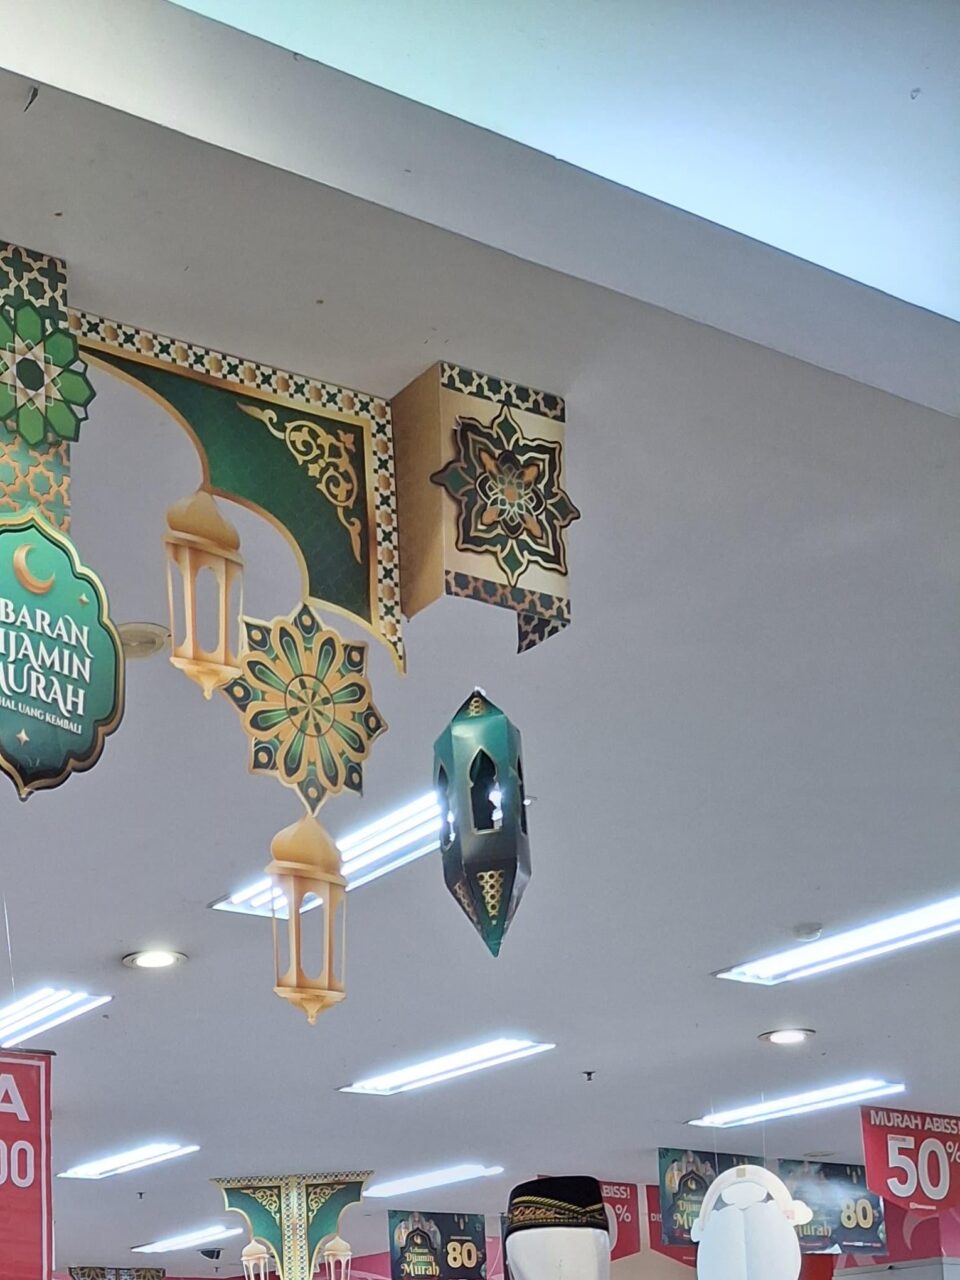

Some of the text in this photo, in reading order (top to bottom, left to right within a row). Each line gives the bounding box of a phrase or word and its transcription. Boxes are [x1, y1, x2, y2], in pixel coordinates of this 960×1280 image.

[19, 704, 44, 722] UANG
[45, 713, 82, 735] KEMBALI
[869, 1109, 923, 1130] MURAH
[400, 1261, 440, 1277] Murah
